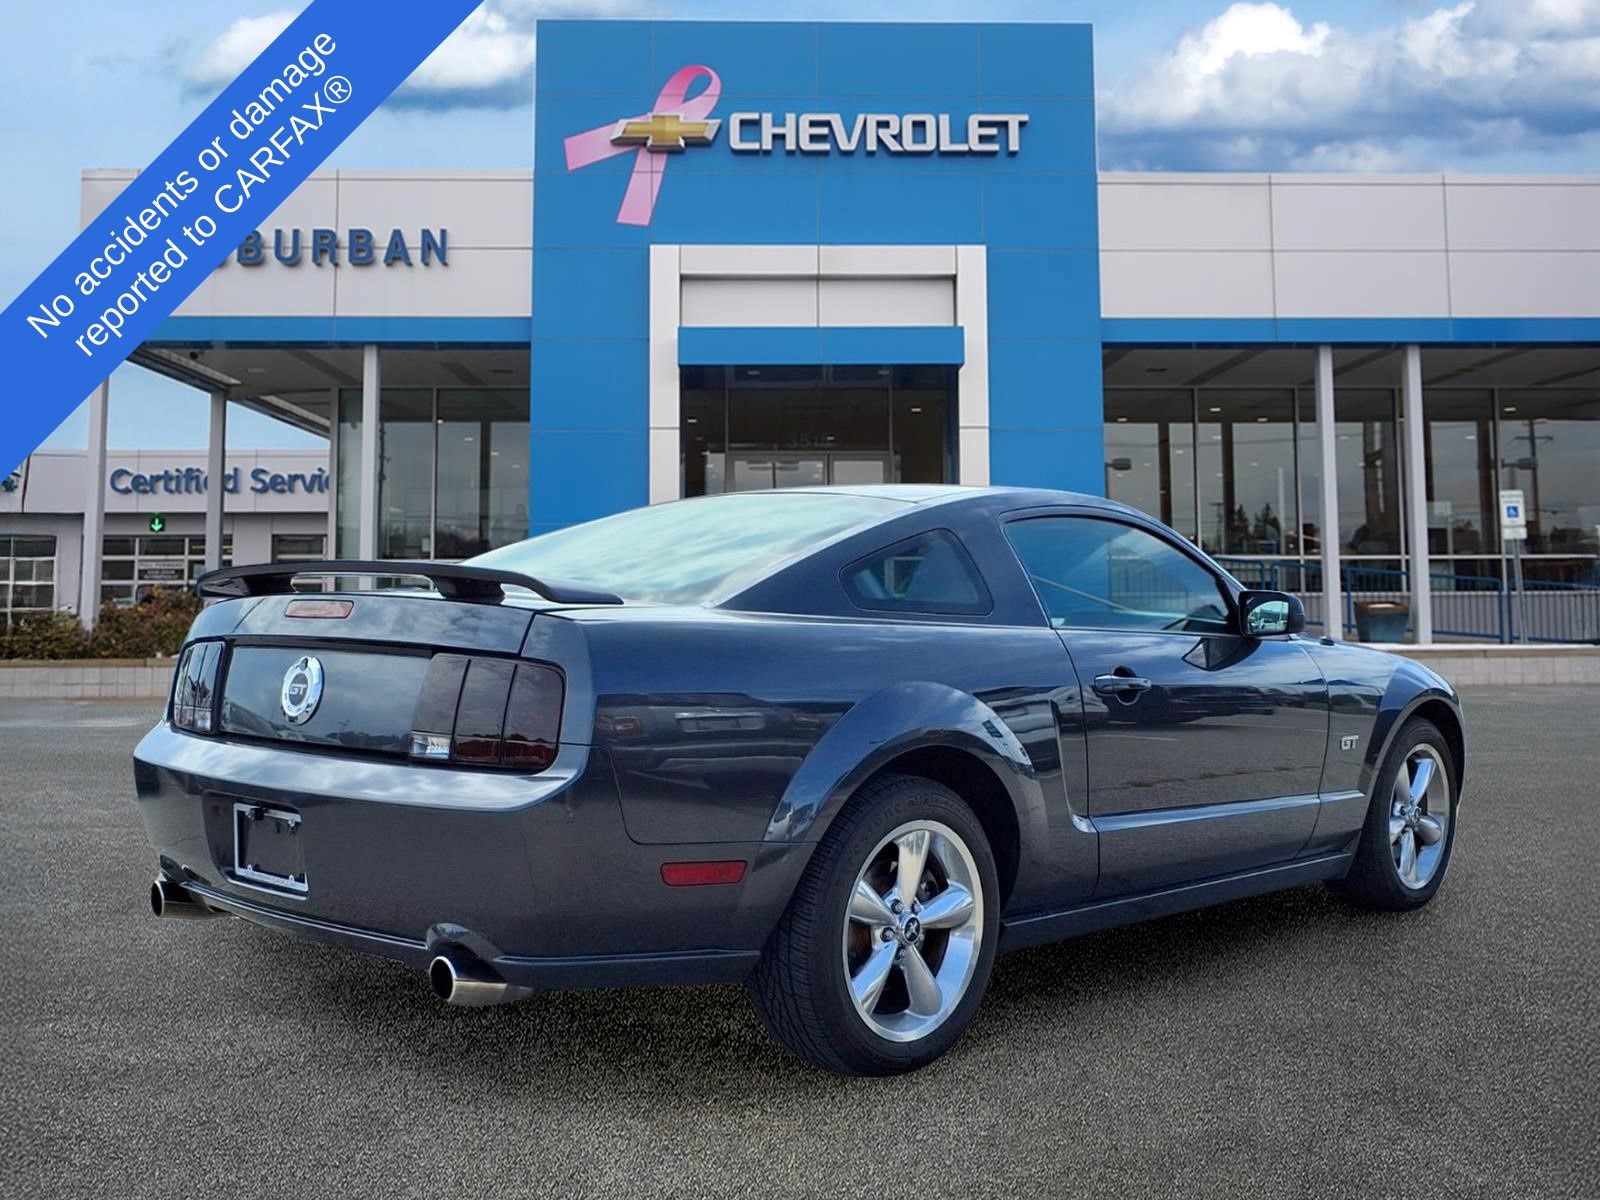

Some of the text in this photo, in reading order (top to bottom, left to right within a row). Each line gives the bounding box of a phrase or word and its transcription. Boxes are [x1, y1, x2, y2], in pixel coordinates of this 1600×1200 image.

[729, 112, 1030, 152] CHEVROLET
[109, 467, 240, 494] Certifid
[289, 683, 307, 696] GT
[1341, 735, 1359, 750] GT
